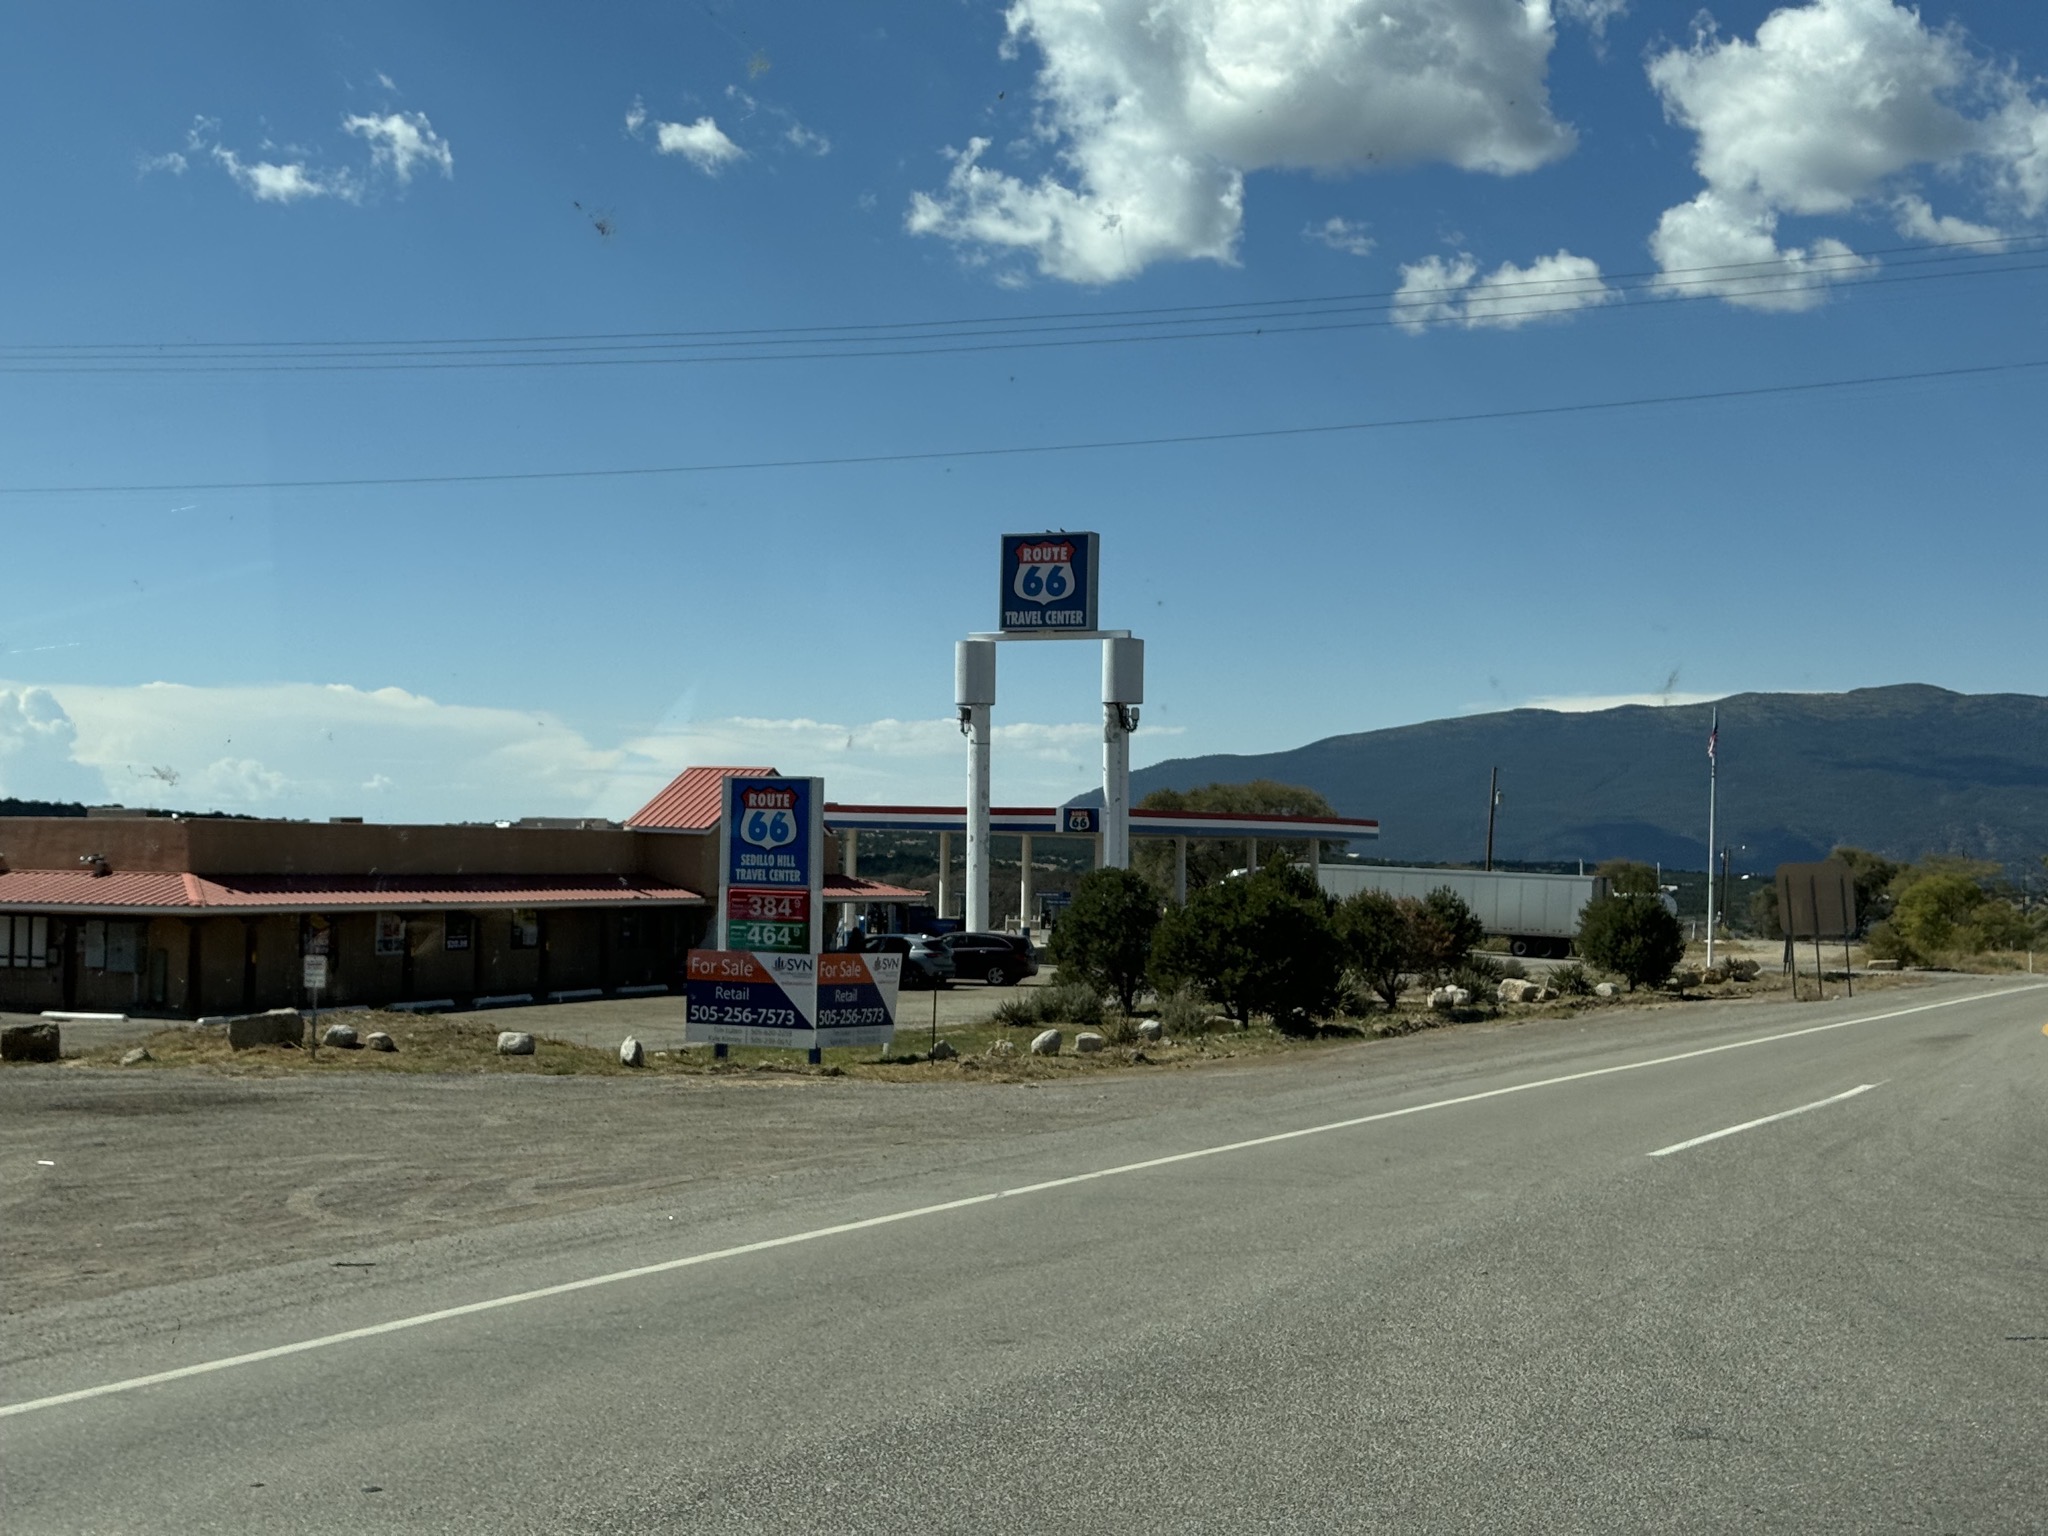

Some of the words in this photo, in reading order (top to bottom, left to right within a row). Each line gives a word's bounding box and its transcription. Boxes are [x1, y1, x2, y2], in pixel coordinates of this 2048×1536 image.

[1023, 546, 1068, 562] ROUTE
[1022, 565, 1067, 597] 66
[1005, 610, 1043, 625] TRAVEL
[1045, 610, 1084, 624] CENTER
[748, 793, 790, 807] ROUTE
[748, 810, 789, 842] 66
[1072, 817, 1087, 828] 66
[740, 854, 774, 867] SEDILLO
[776, 855, 795, 868] HILL
[735, 868, 767, 881] TRAVEL
[768, 869, 801, 882] CENTER
[748, 896, 792, 917] 384
[747, 925, 792, 945] 464
[691, 957, 717, 974] For
[721, 958, 754, 977] Sale
[787, 958, 813, 971] SVN
[819, 961, 836, 977] For
[840, 960, 861, 977] Sale
[882, 957, 900, 970] SVN
[715, 986, 750, 1001] Retail
[835, 988, 858, 1002] Retail
[690, 1005, 795, 1026] 505-256-7573
[818, 1007, 885, 1025] 505-256-7573
